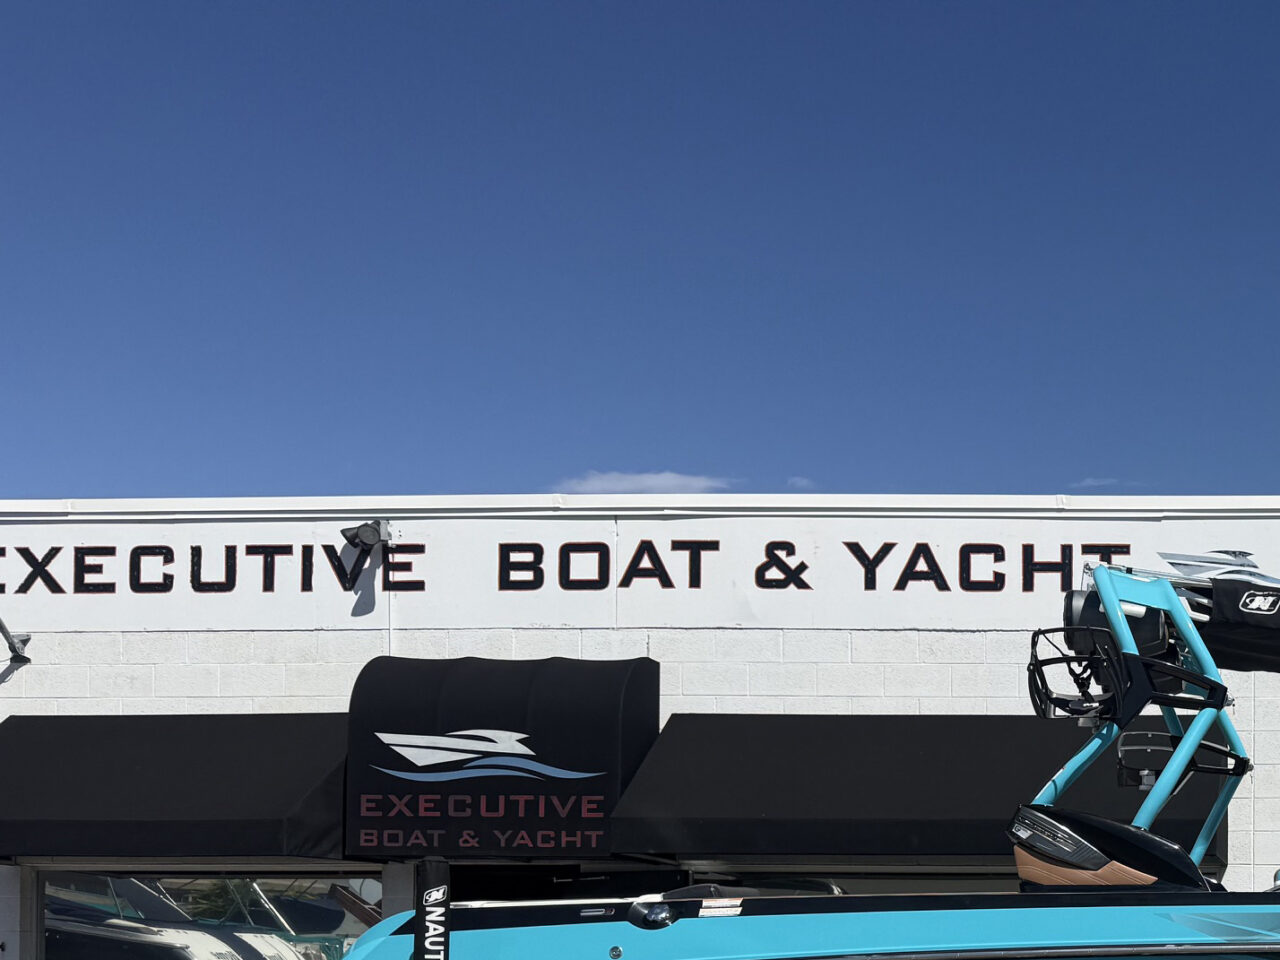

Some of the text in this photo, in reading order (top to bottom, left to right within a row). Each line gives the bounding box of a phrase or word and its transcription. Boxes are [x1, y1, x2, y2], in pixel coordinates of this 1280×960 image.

[0, 543, 426, 594] XECUTIVE
[498, 539, 720, 592] BOAT
[754, 540, 814, 591] &
[359, 794, 605, 818] EXECUTIVE
[359, 829, 604, 848] BOAT & YACHT
